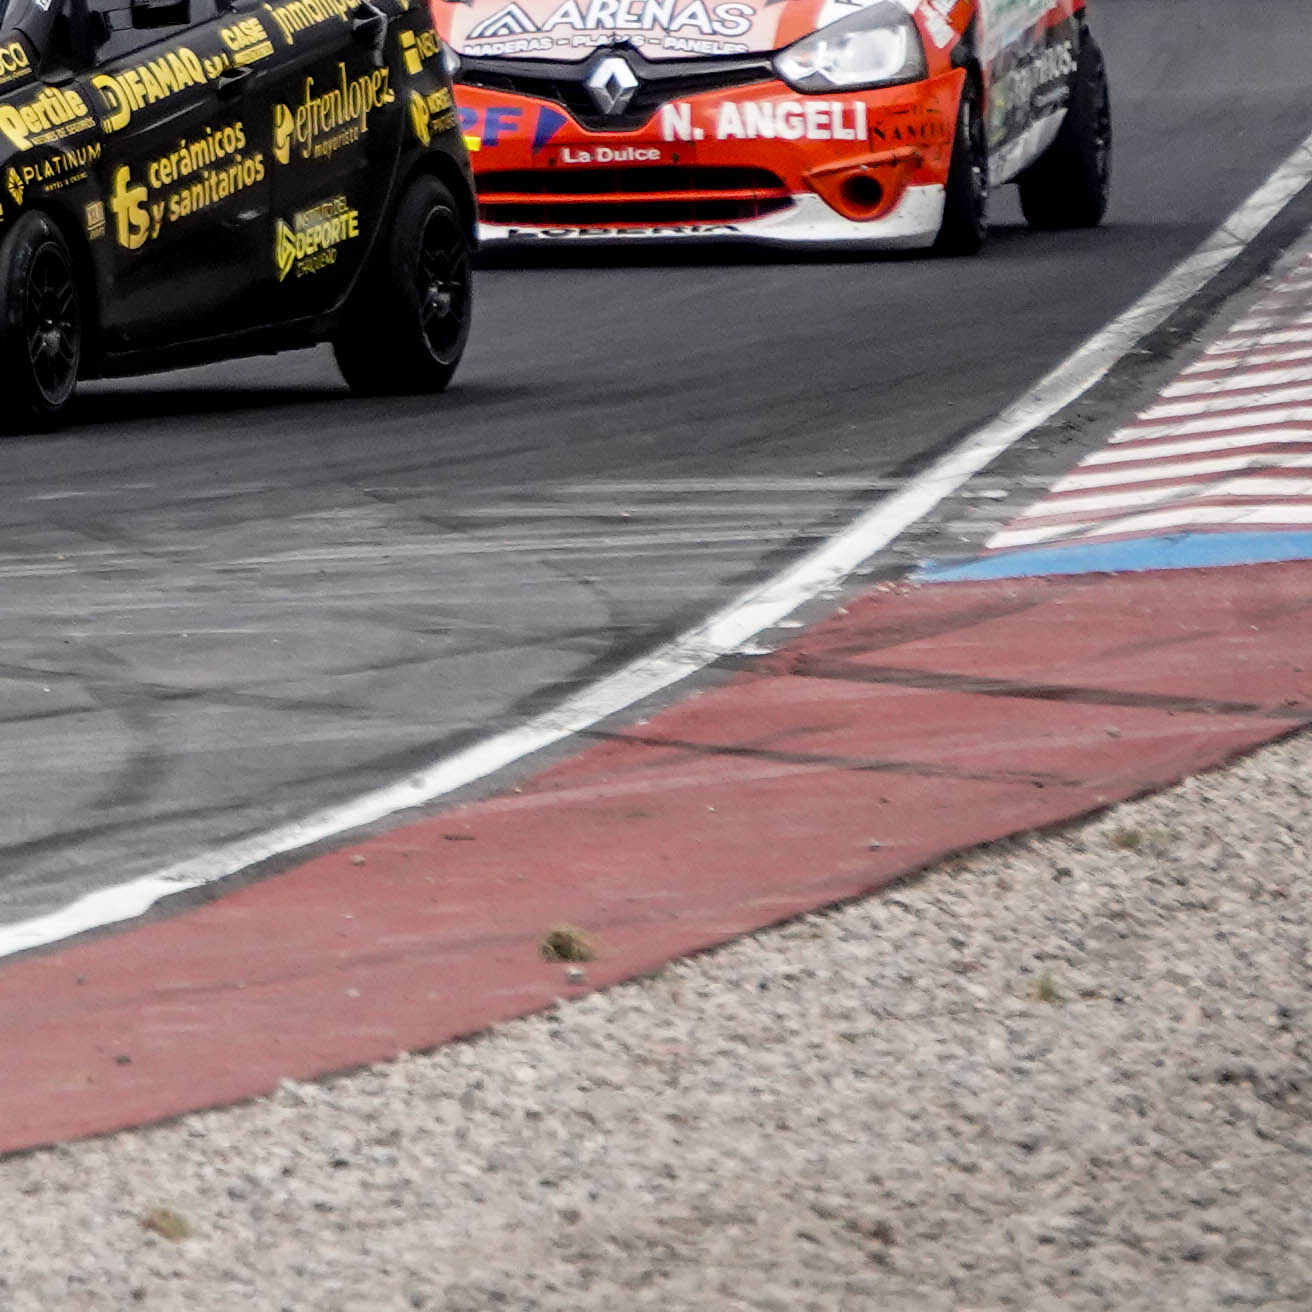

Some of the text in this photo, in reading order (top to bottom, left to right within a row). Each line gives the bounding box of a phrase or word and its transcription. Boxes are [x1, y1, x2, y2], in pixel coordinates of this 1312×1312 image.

[463, 36, 554, 56] MADERAS
[661, 100, 868, 141] N. ANGELI
[23, 141, 103, 186] PLATINUM
[148, 118, 247, 190] cerámicos
[562, 146, 662, 164] La Dulce
[150, 204, 166, 241] y
[169, 151, 266, 224] sanitarios
[295, 210, 361, 261] DEPORTE
